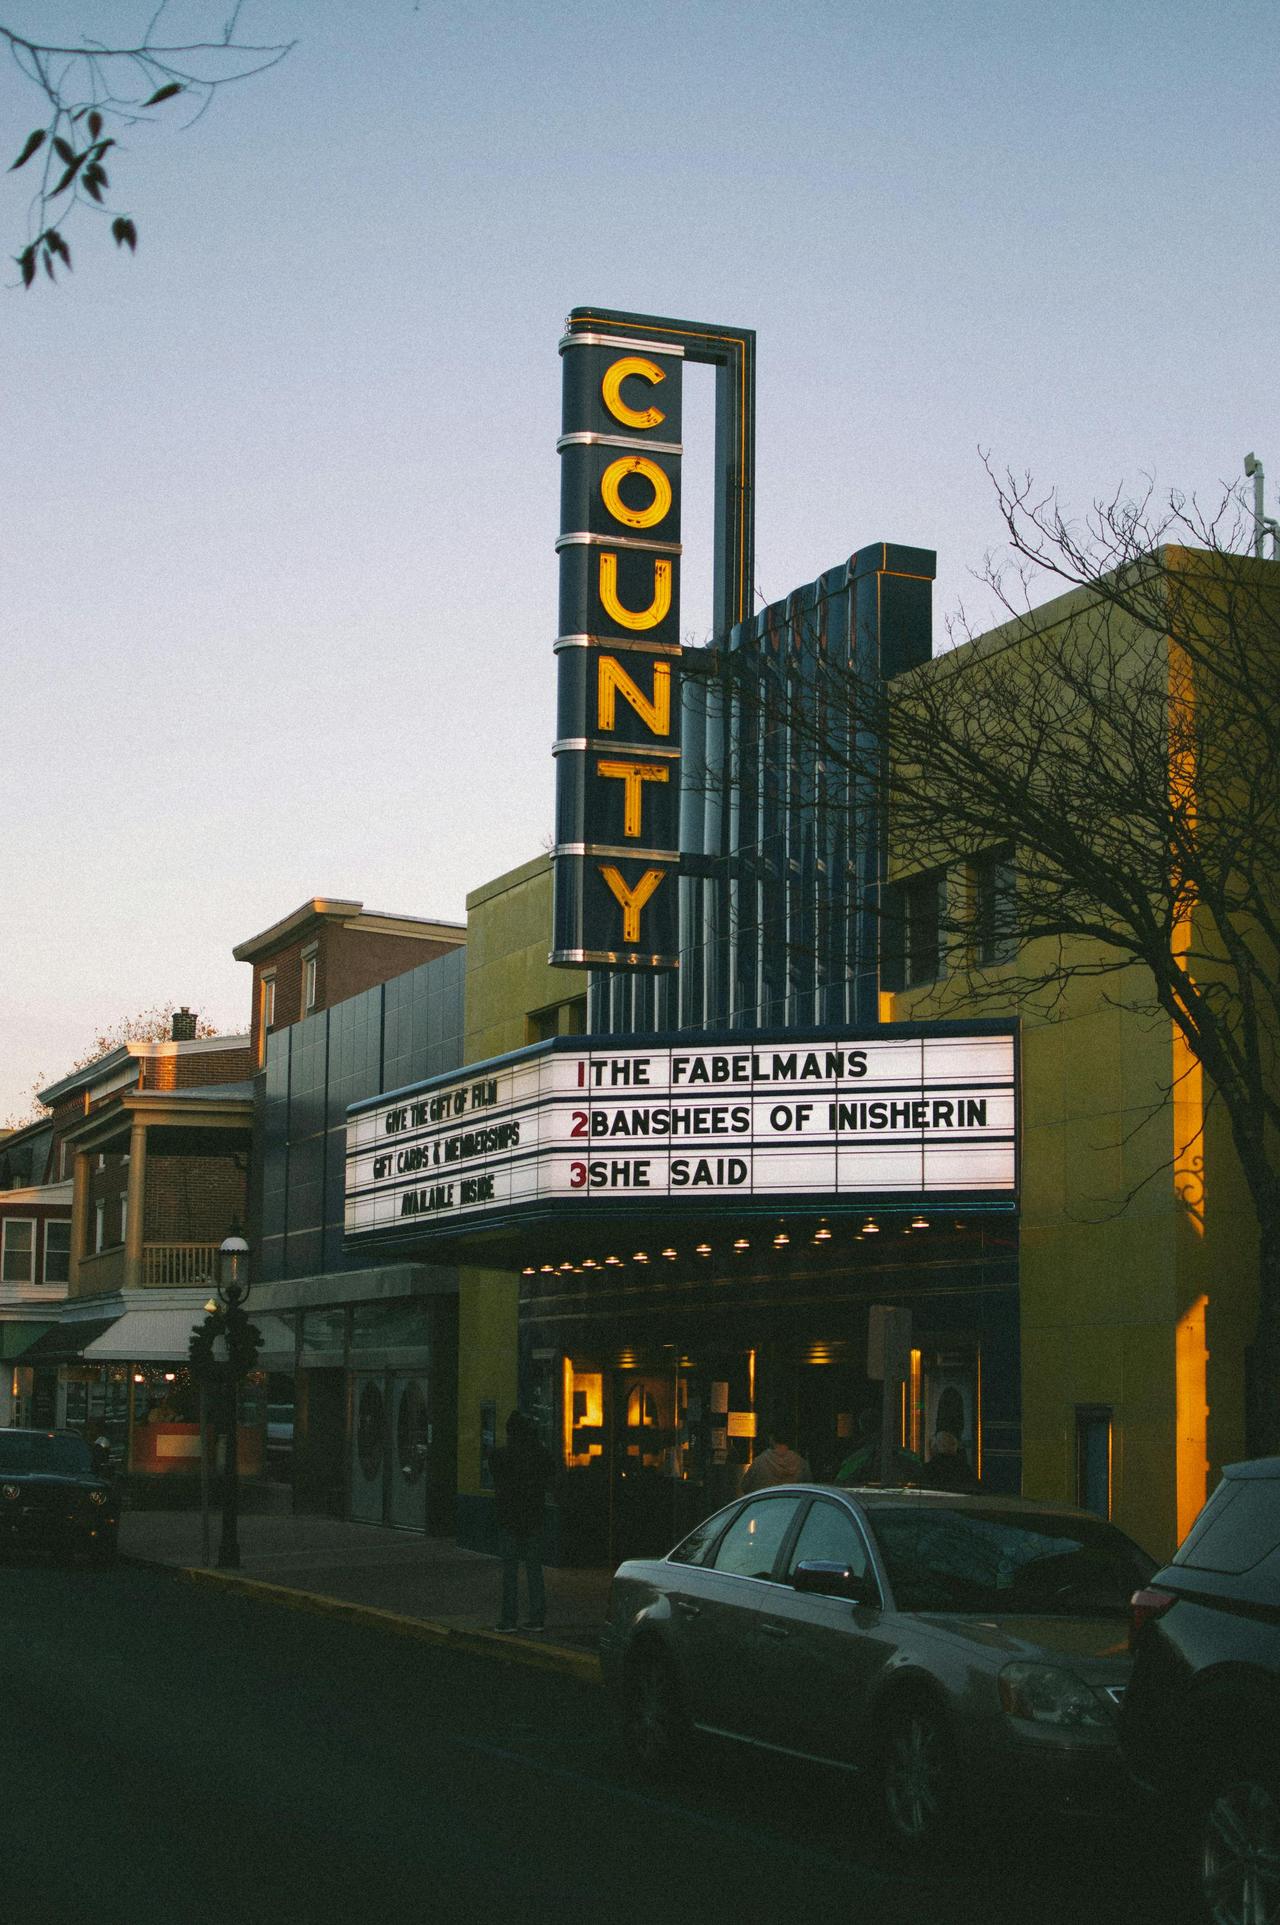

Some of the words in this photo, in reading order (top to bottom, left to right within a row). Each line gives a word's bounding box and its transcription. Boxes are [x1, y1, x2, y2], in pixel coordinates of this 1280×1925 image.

[596, 355, 672, 943] COUNTY
[590, 1058, 650, 1086] THE
[672, 1050, 868, 1084] FABELMANS
[386, 1108, 408, 1134] GIVE
[411, 1101, 428, 1127] THE
[430, 1094, 451, 1121] GIFT
[454, 1088, 468, 1115] OF
[472, 1080, 497, 1109] FILM
[590, 1106, 750, 1136] BANSHEES
[770, 1103, 813, 1132] OF
[829, 1099, 987, 1130] INISHERIN
[373, 1154, 393, 1180] GIFT
[397, 1145, 429, 1174] CARDS
[445, 1121, 520, 1163] MEMBERSHIPS
[590, 1160, 651, 1187] SHE
[671, 1158, 748, 1186] SAID
[401, 1184, 454, 1216] AVAILABLE
[460, 1174, 495, 1204] INSIDE
